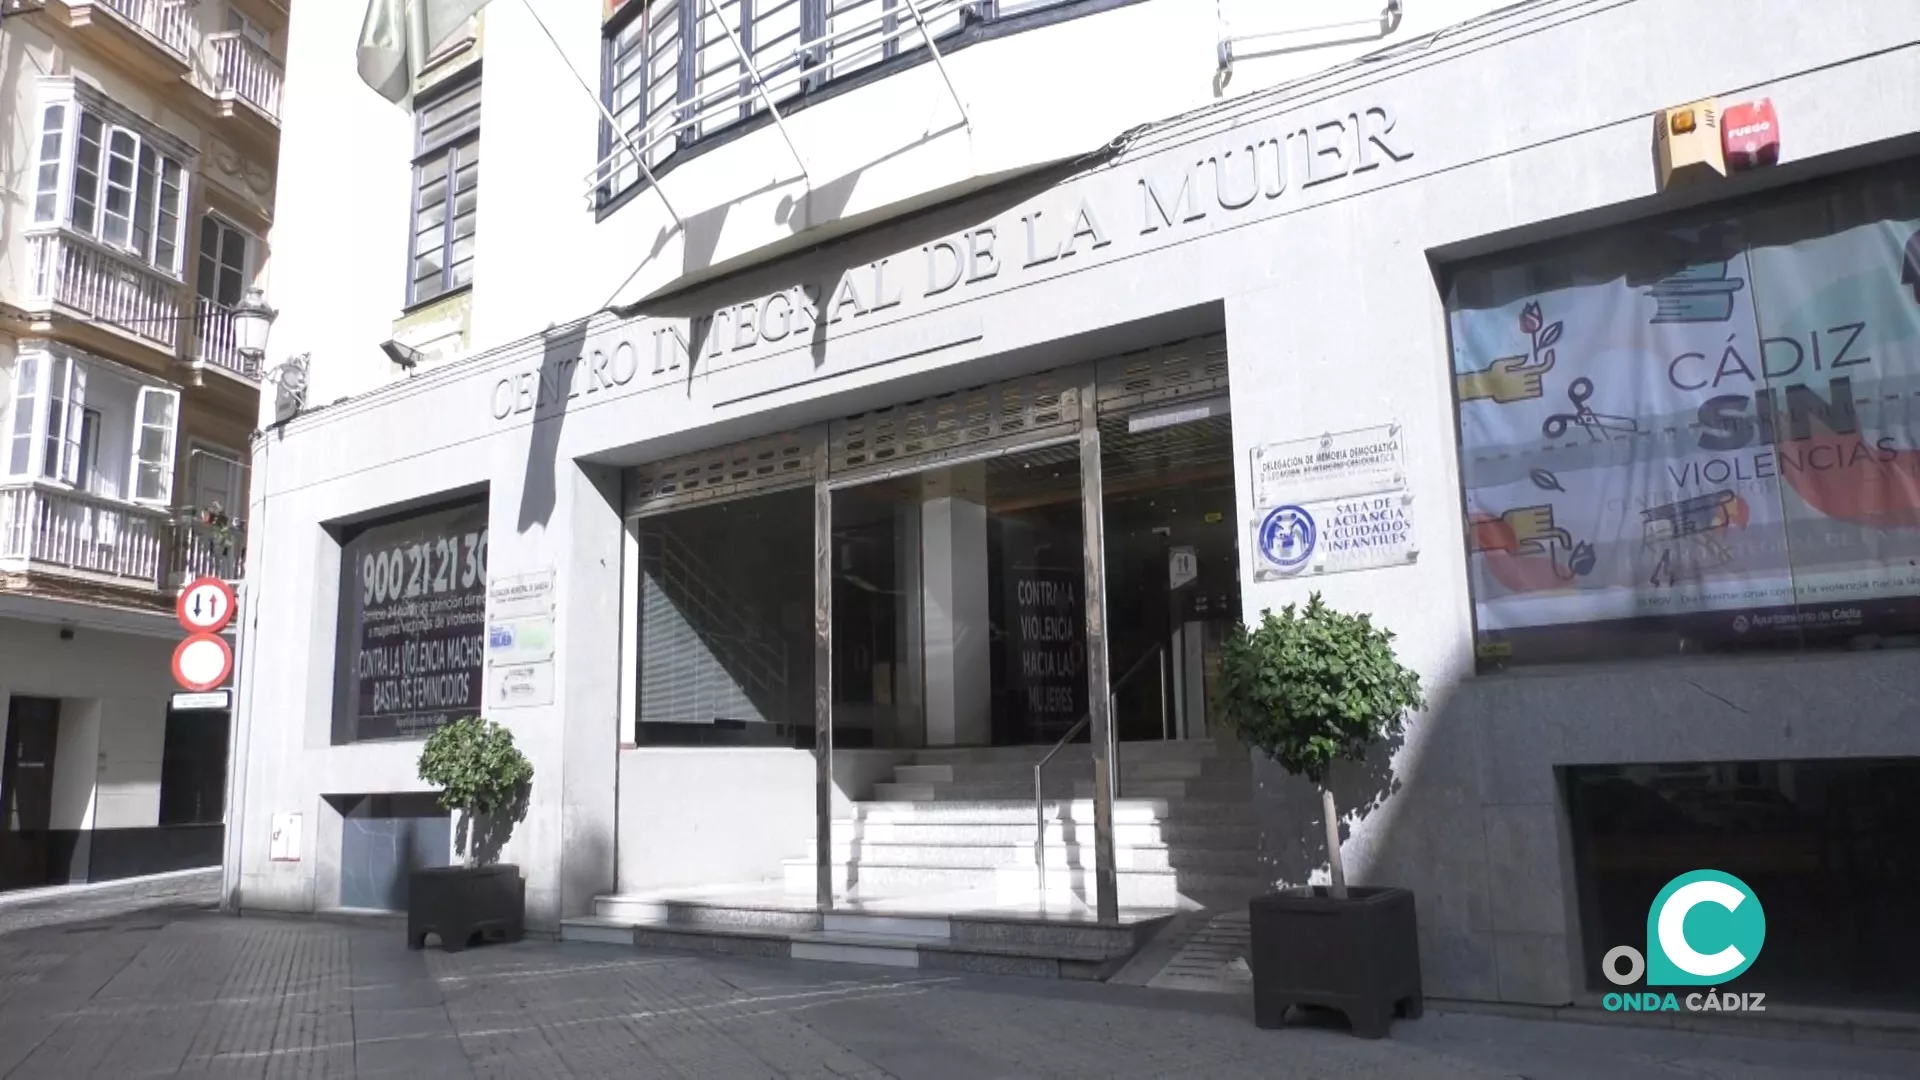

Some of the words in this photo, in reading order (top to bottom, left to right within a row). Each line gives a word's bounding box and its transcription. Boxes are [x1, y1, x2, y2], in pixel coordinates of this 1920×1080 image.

[1727, 121, 1771, 139] FUEGO
[490, 340, 640, 421] CENTRO
[651, 260, 903, 376] INTEGRAL
[922, 225, 1001, 298] DE
[1021, 196, 1112, 270] LA
[1138, 106, 1415, 236] MUJER
[1668, 321, 1871, 392] CÁDIZ
[1698, 376, 1857, 451] SIN
[1668, 437, 1898, 489] VIOLENCIAS
[1326, 508, 1405, 529] LACTANCIA
[1336, 500, 1369, 515] SALA
[1374, 497, 1392, 510] DE
[1322, 530, 1329, 541] Y
[1334, 519, 1411, 538] CUIDADOS
[1328, 531, 1407, 552] INFANTILES
[363, 548, 403, 606] 900
[406, 541, 431, 598] 21
[433, 535, 458, 593] 21
[1820, 578, 1870, 593] violencia
[1020, 615, 1073, 641] VIOLENCIA
[360, 647, 388, 679] CONTRA
[389, 644, 400, 676] LA
[401, 639, 445, 674] VIOLENCIA
[1023, 650, 1055, 677] HACIA
[374, 680, 400, 713] BASTA
[401, 678, 412, 709] DE
[414, 672, 470, 708] FEMINICIDIOS
[1028, 685, 1073, 712] MUJERES
